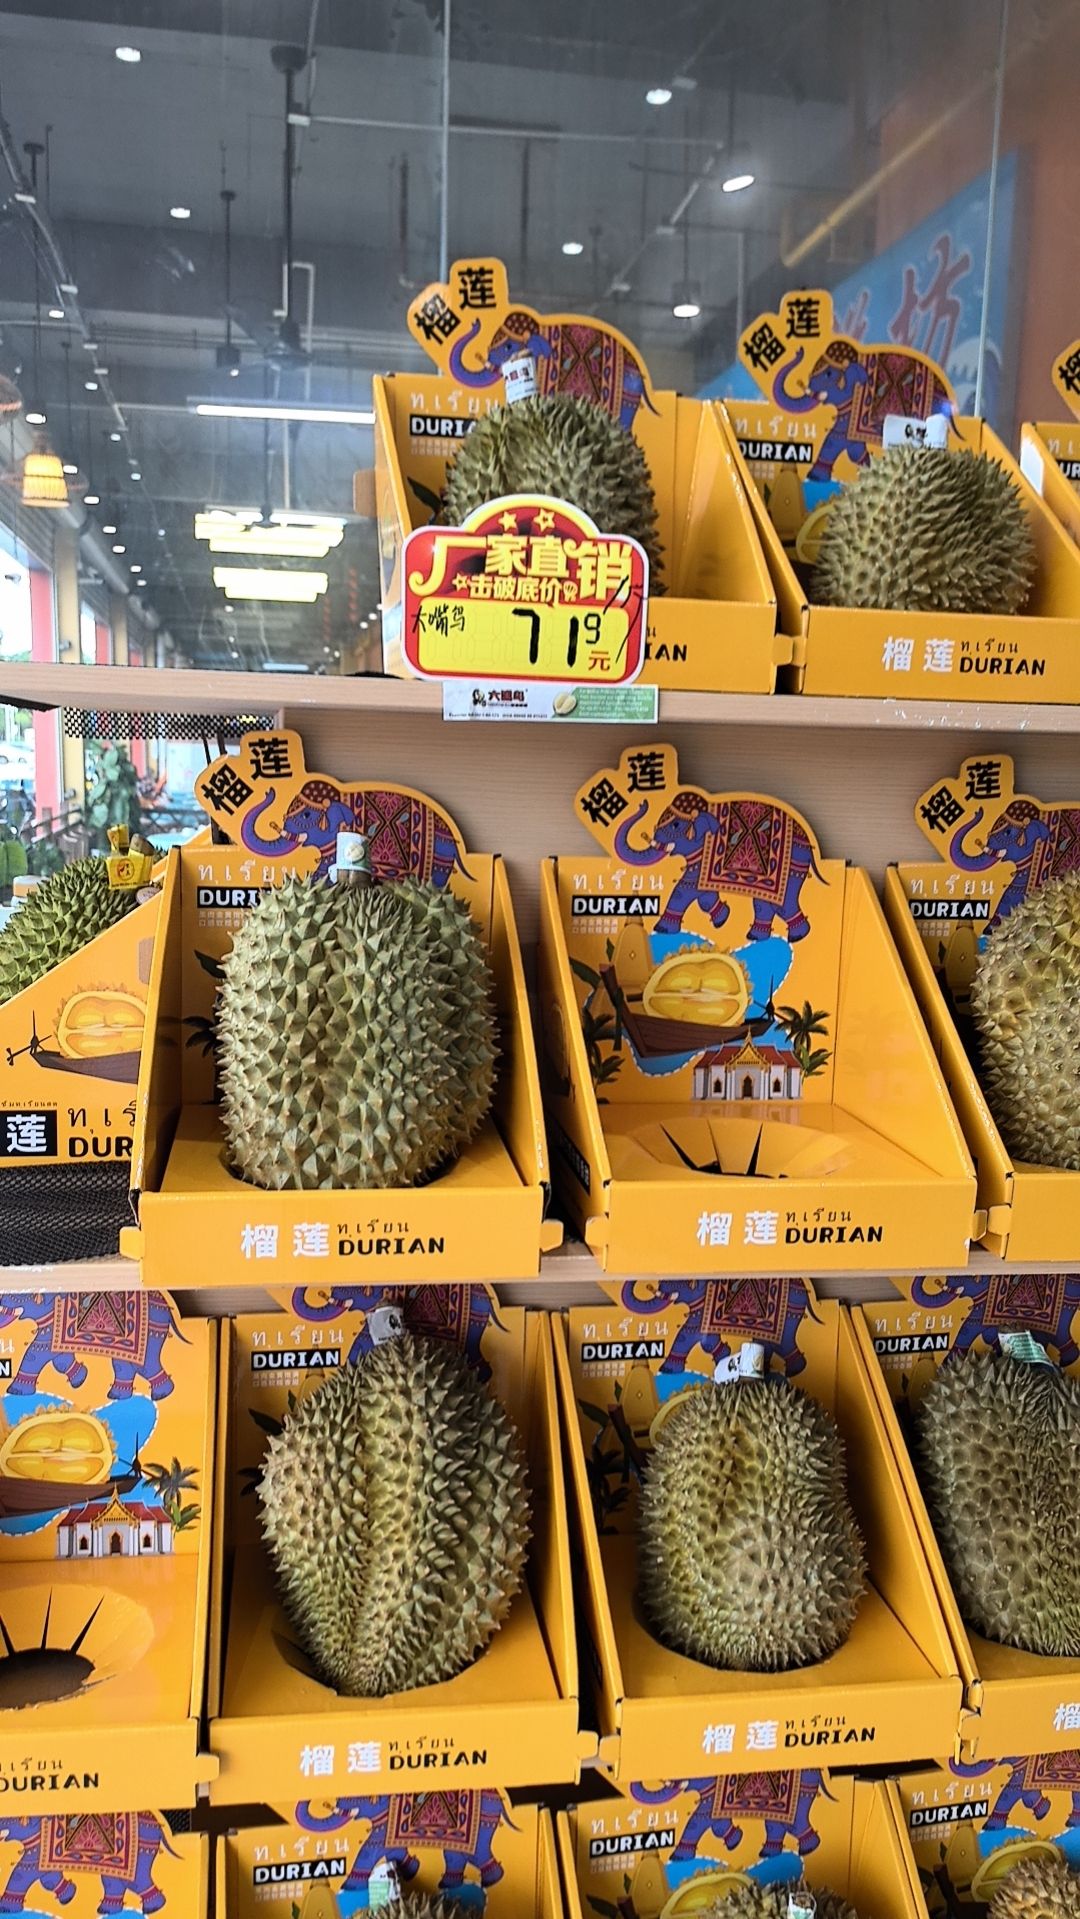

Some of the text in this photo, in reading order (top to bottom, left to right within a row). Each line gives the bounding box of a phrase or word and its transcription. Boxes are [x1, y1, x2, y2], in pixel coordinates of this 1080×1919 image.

[414, 267, 497, 344] 榴莲
[743, 298, 820, 372] 榴莲
[408, 534, 633, 599] 厂家直销
[466, 573, 561, 603] 击破底价
[588, 650, 611, 671] 元
[646, 643, 687, 661] IAN
[882, 636, 955, 672] 榴莲
[959, 657, 1045, 676] DURIAN
[201, 738, 292, 815] 榴莲
[580, 752, 666, 827] 榴莲
[920, 761, 1001, 833] 榴莲
[200, 889, 258, 906] DURI
[573, 898, 659, 914] DURIAN
[911, 902, 989, 917] DURIAN
[69, 1136, 134, 1157] DUR
[241, 1222, 330, 1258] 榴莲
[697, 1211, 780, 1246] 榴莲
[785, 1226, 882, 1244] DURIAN
[339, 1237, 444, 1255] DURIAN
[583, 1343, 664, 1360] DURIAN
[875, 1335, 948, 1353] DURIAN
[253, 1351, 339, 1369] DURIAN
[702, 1720, 779, 1754] 榴莲
[784, 1727, 875, 1747] DURIAN
[300, 1741, 382, 1777] 榴莲
[389, 1750, 487, 1770] DURIAN
[912, 1802, 987, 1826] DURIAN
[591, 1831, 674, 1856] DURIAN
[255, 1859, 345, 1883] DURIAN
